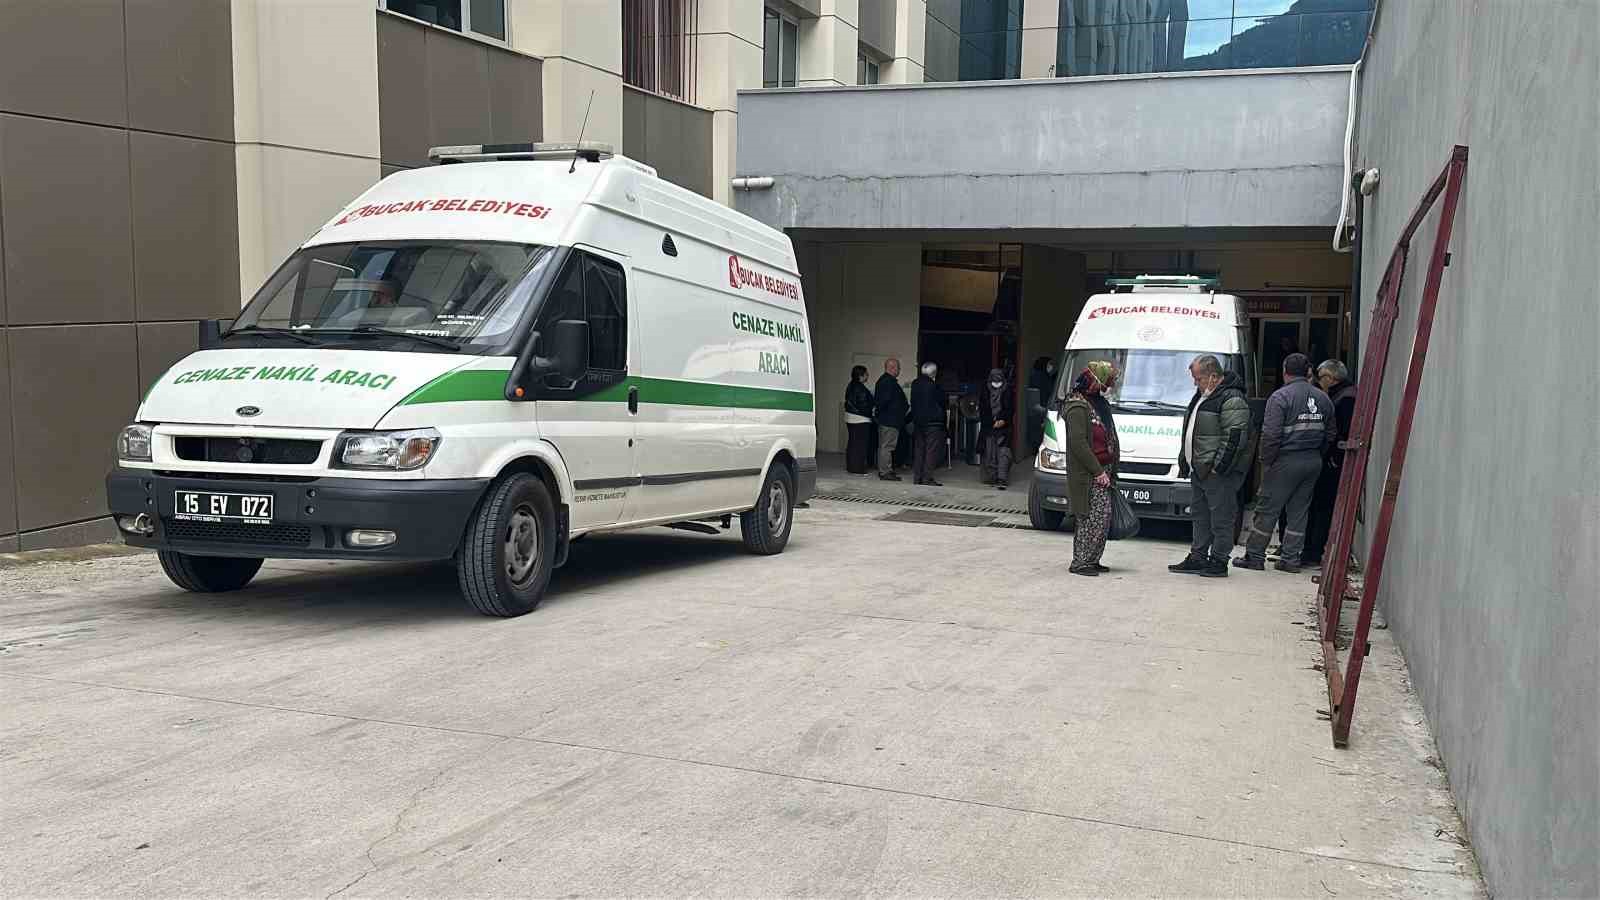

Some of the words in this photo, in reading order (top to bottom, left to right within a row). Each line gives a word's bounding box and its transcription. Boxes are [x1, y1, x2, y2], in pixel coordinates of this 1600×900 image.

[361, 199, 430, 218] BUCAK
[740, 267, 765, 290] BUCAK
[1106, 305, 1147, 315] BUCAK
[732, 311, 775, 337] CENAZE
[776, 322, 805, 343] NAKİL
[758, 351, 790, 376] ARACI
[173, 366, 256, 385] CENAZE
[252, 363, 319, 383] NAKİL
[320, 369, 398, 390] ARACI
[1156, 425, 1182, 437] ARA
[184, 493, 199, 513] 15
[210, 495, 228, 515] EV
[241, 496, 269, 517] 072
[1133, 490, 1150, 500] 600
